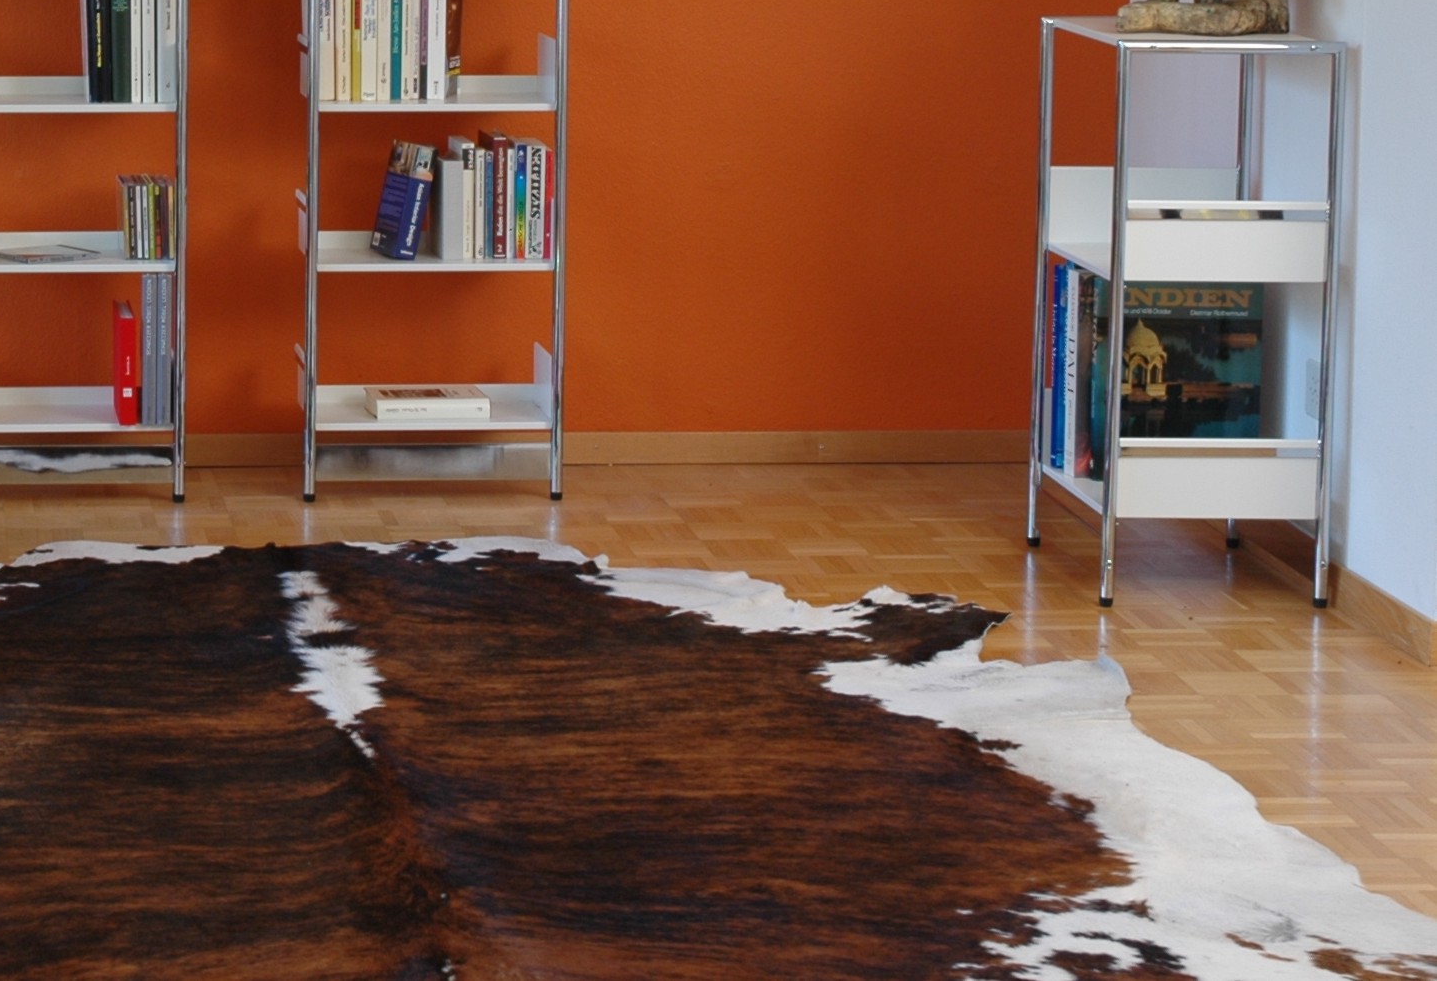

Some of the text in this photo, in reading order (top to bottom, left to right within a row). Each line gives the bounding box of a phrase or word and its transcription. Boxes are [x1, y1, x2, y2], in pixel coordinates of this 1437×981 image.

[497, 147, 505, 178] bewegten
[496, 178, 504, 194] Welt
[530, 146, 542, 220] SIZILIEN
[496, 216, 504, 236] Reden
[497, 244, 503, 253] 2
[1124, 287, 1253, 308] NDIEN
